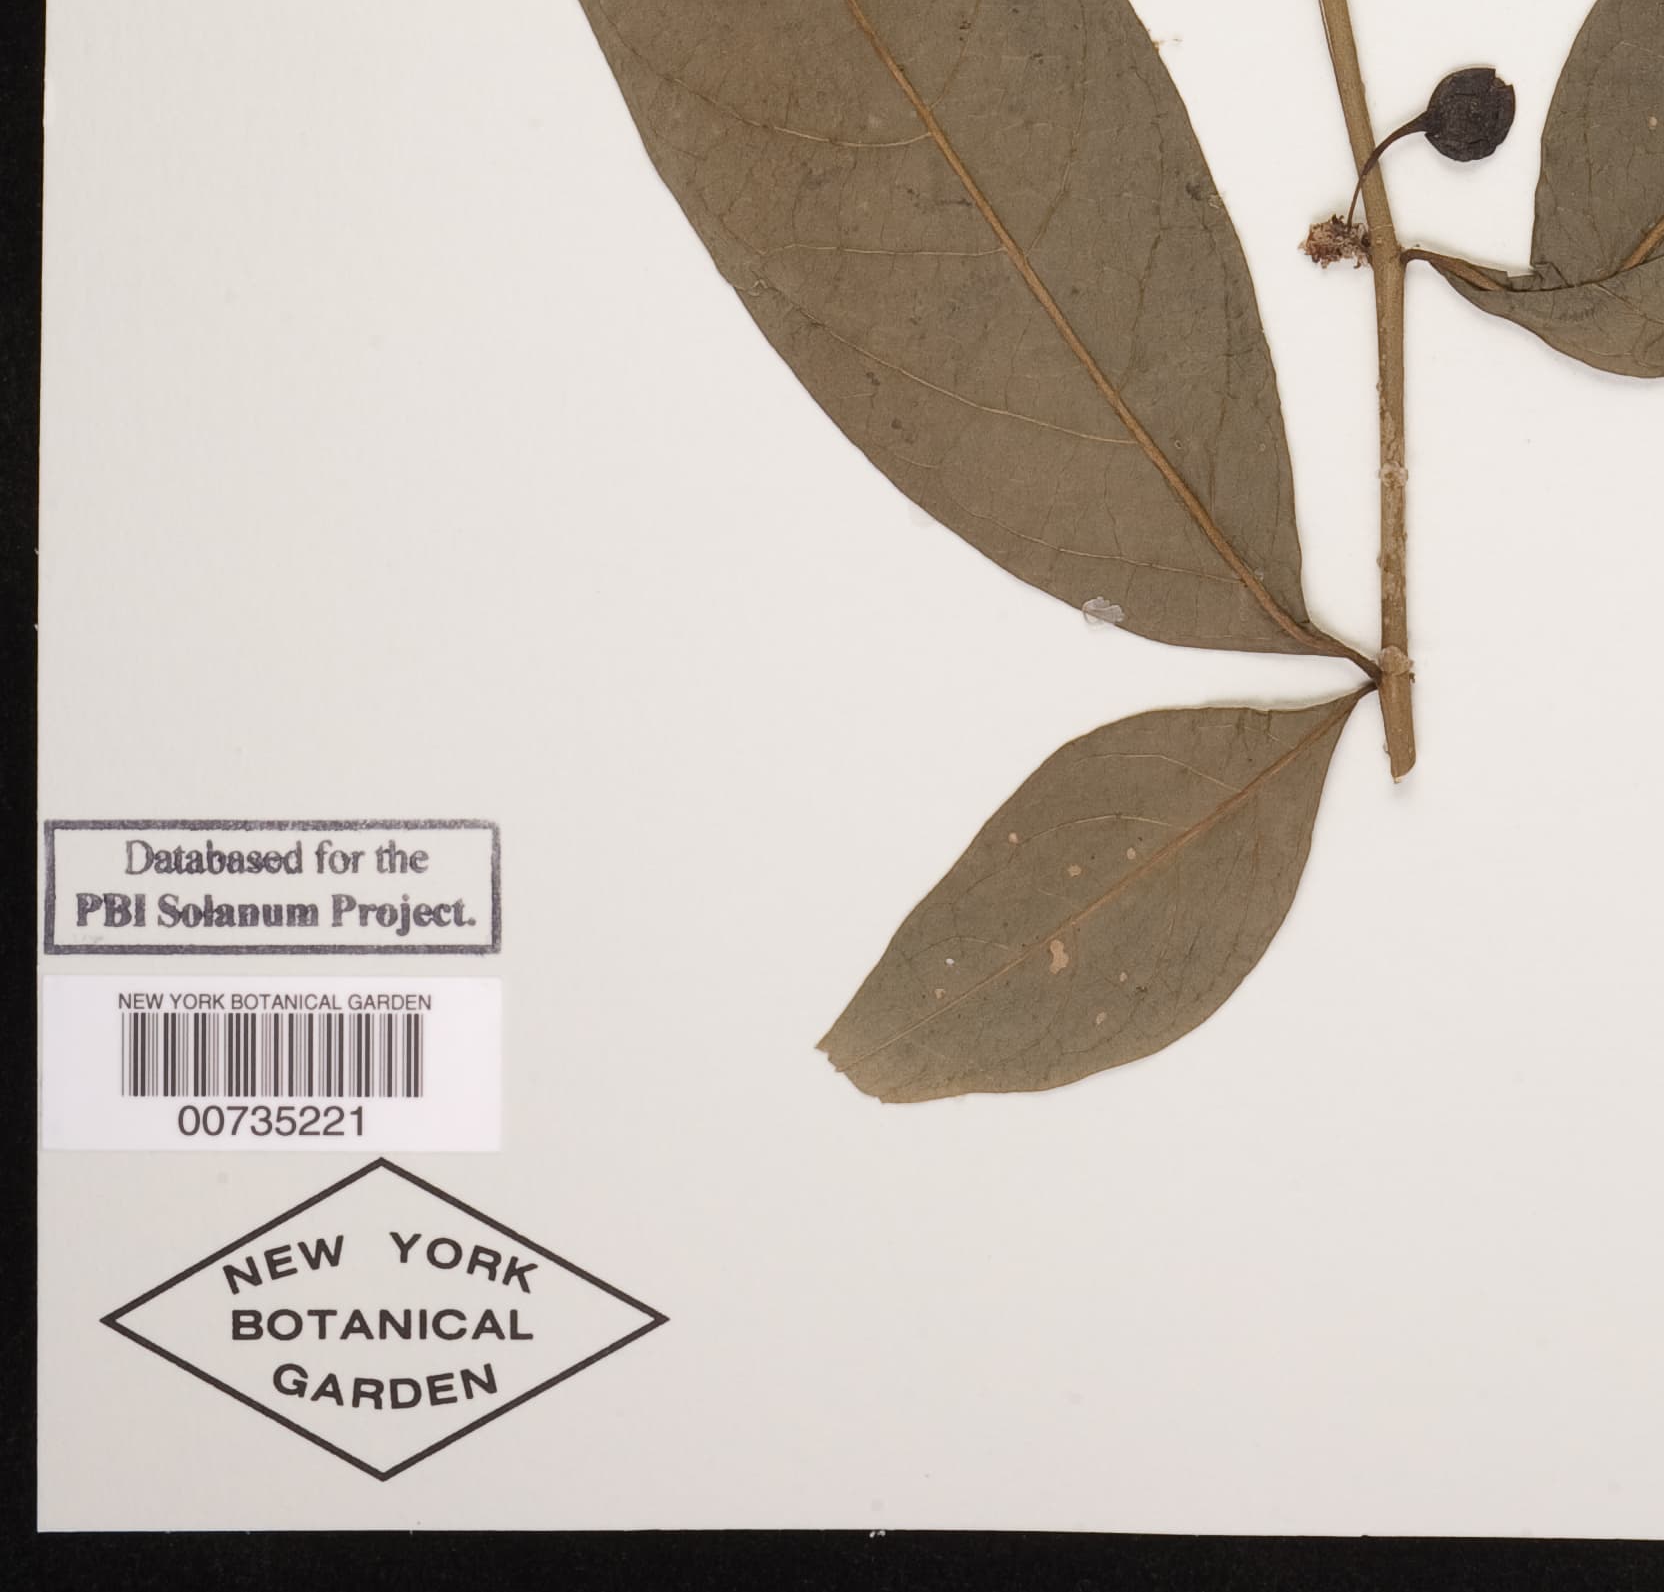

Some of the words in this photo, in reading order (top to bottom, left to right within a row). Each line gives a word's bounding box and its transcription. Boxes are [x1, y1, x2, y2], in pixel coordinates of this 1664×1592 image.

[124, 838, 304, 877] Databased
[313, 838, 361, 876] for
[374, 838, 430, 875] the
[74, 891, 147, 929] PBI
[156, 892, 320, 930] Solanum
[330, 892, 478, 938] Project.
[117, 992, 165, 1011] NEW
[168, 992, 226, 1011] YORK
[230, 992, 343, 1012] BOTANICAL
[346, 992, 433, 1012] GARDEN
[176, 1103, 364, 1138] 00735221
[217, 1232, 346, 1297] NEW
[388, 1227, 542, 1295] YORK
[230, 1307, 535, 1343] BOTANICAL
[271, 1361, 503, 1413] GARDEN
